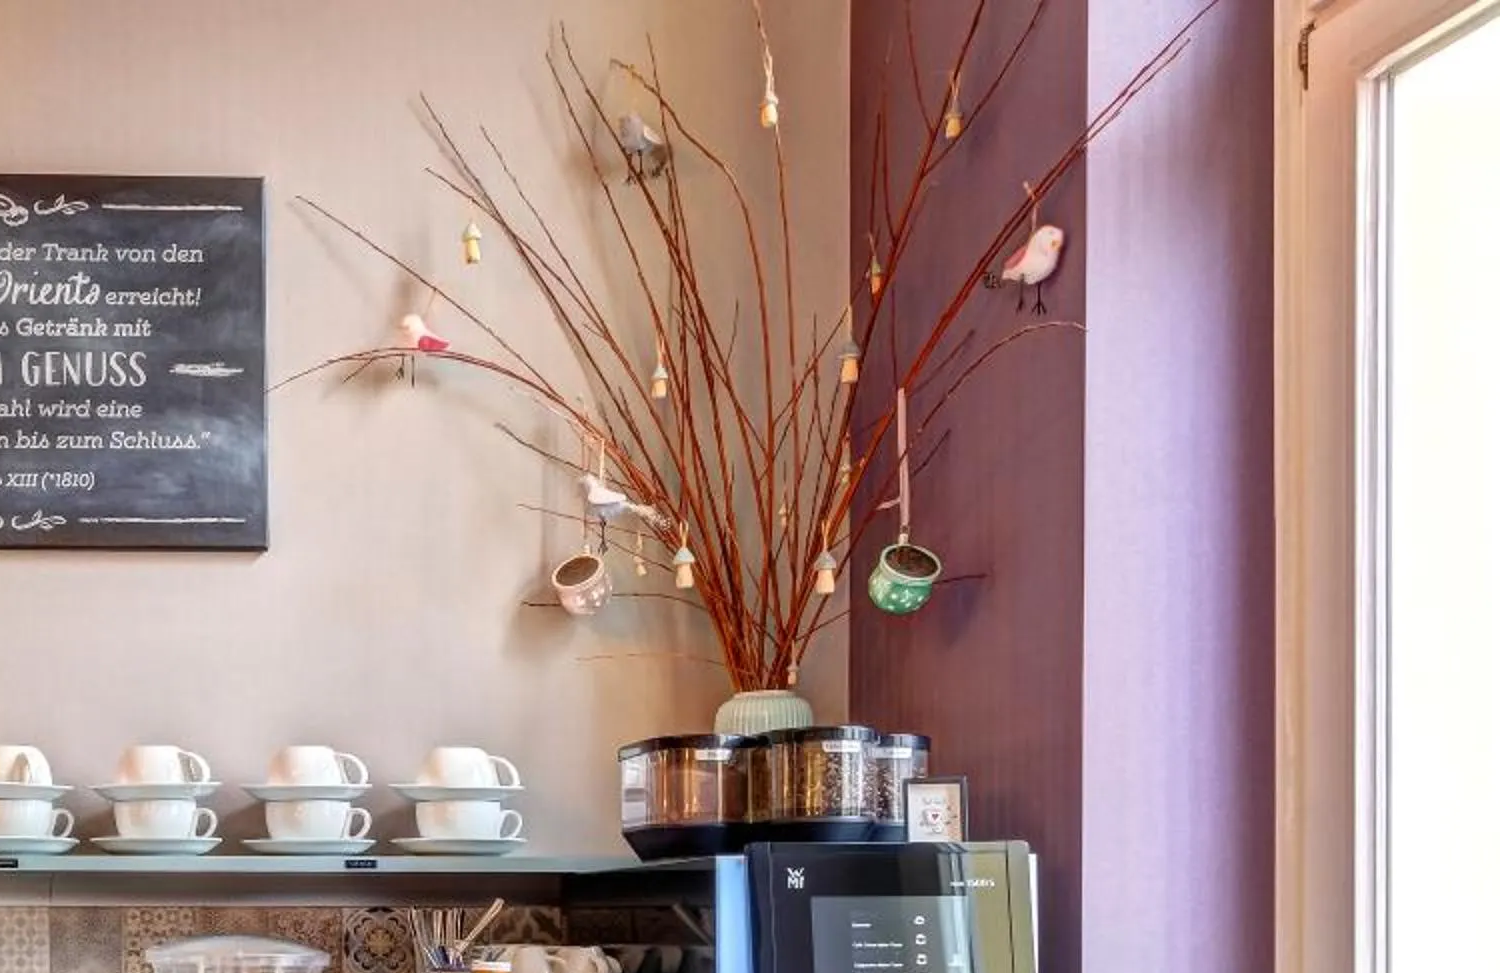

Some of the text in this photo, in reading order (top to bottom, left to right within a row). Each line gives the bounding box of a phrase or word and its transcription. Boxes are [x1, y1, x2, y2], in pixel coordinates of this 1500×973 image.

[41, 243, 109, 262] Trank
[115, 246, 156, 262] von
[161, 245, 204, 263] den
[105, 287, 202, 307] erreicht!
[15, 317, 109, 337] Getränk
[112, 319, 151, 337] mit
[21, 351, 148, 387] GENUSS
[38, 401, 92, 419] wird
[96, 402, 143, 419] eine
[15, 431, 51, 449] bis
[55, 433, 104, 450] zum
[6, 472, 38, 487] XIII
